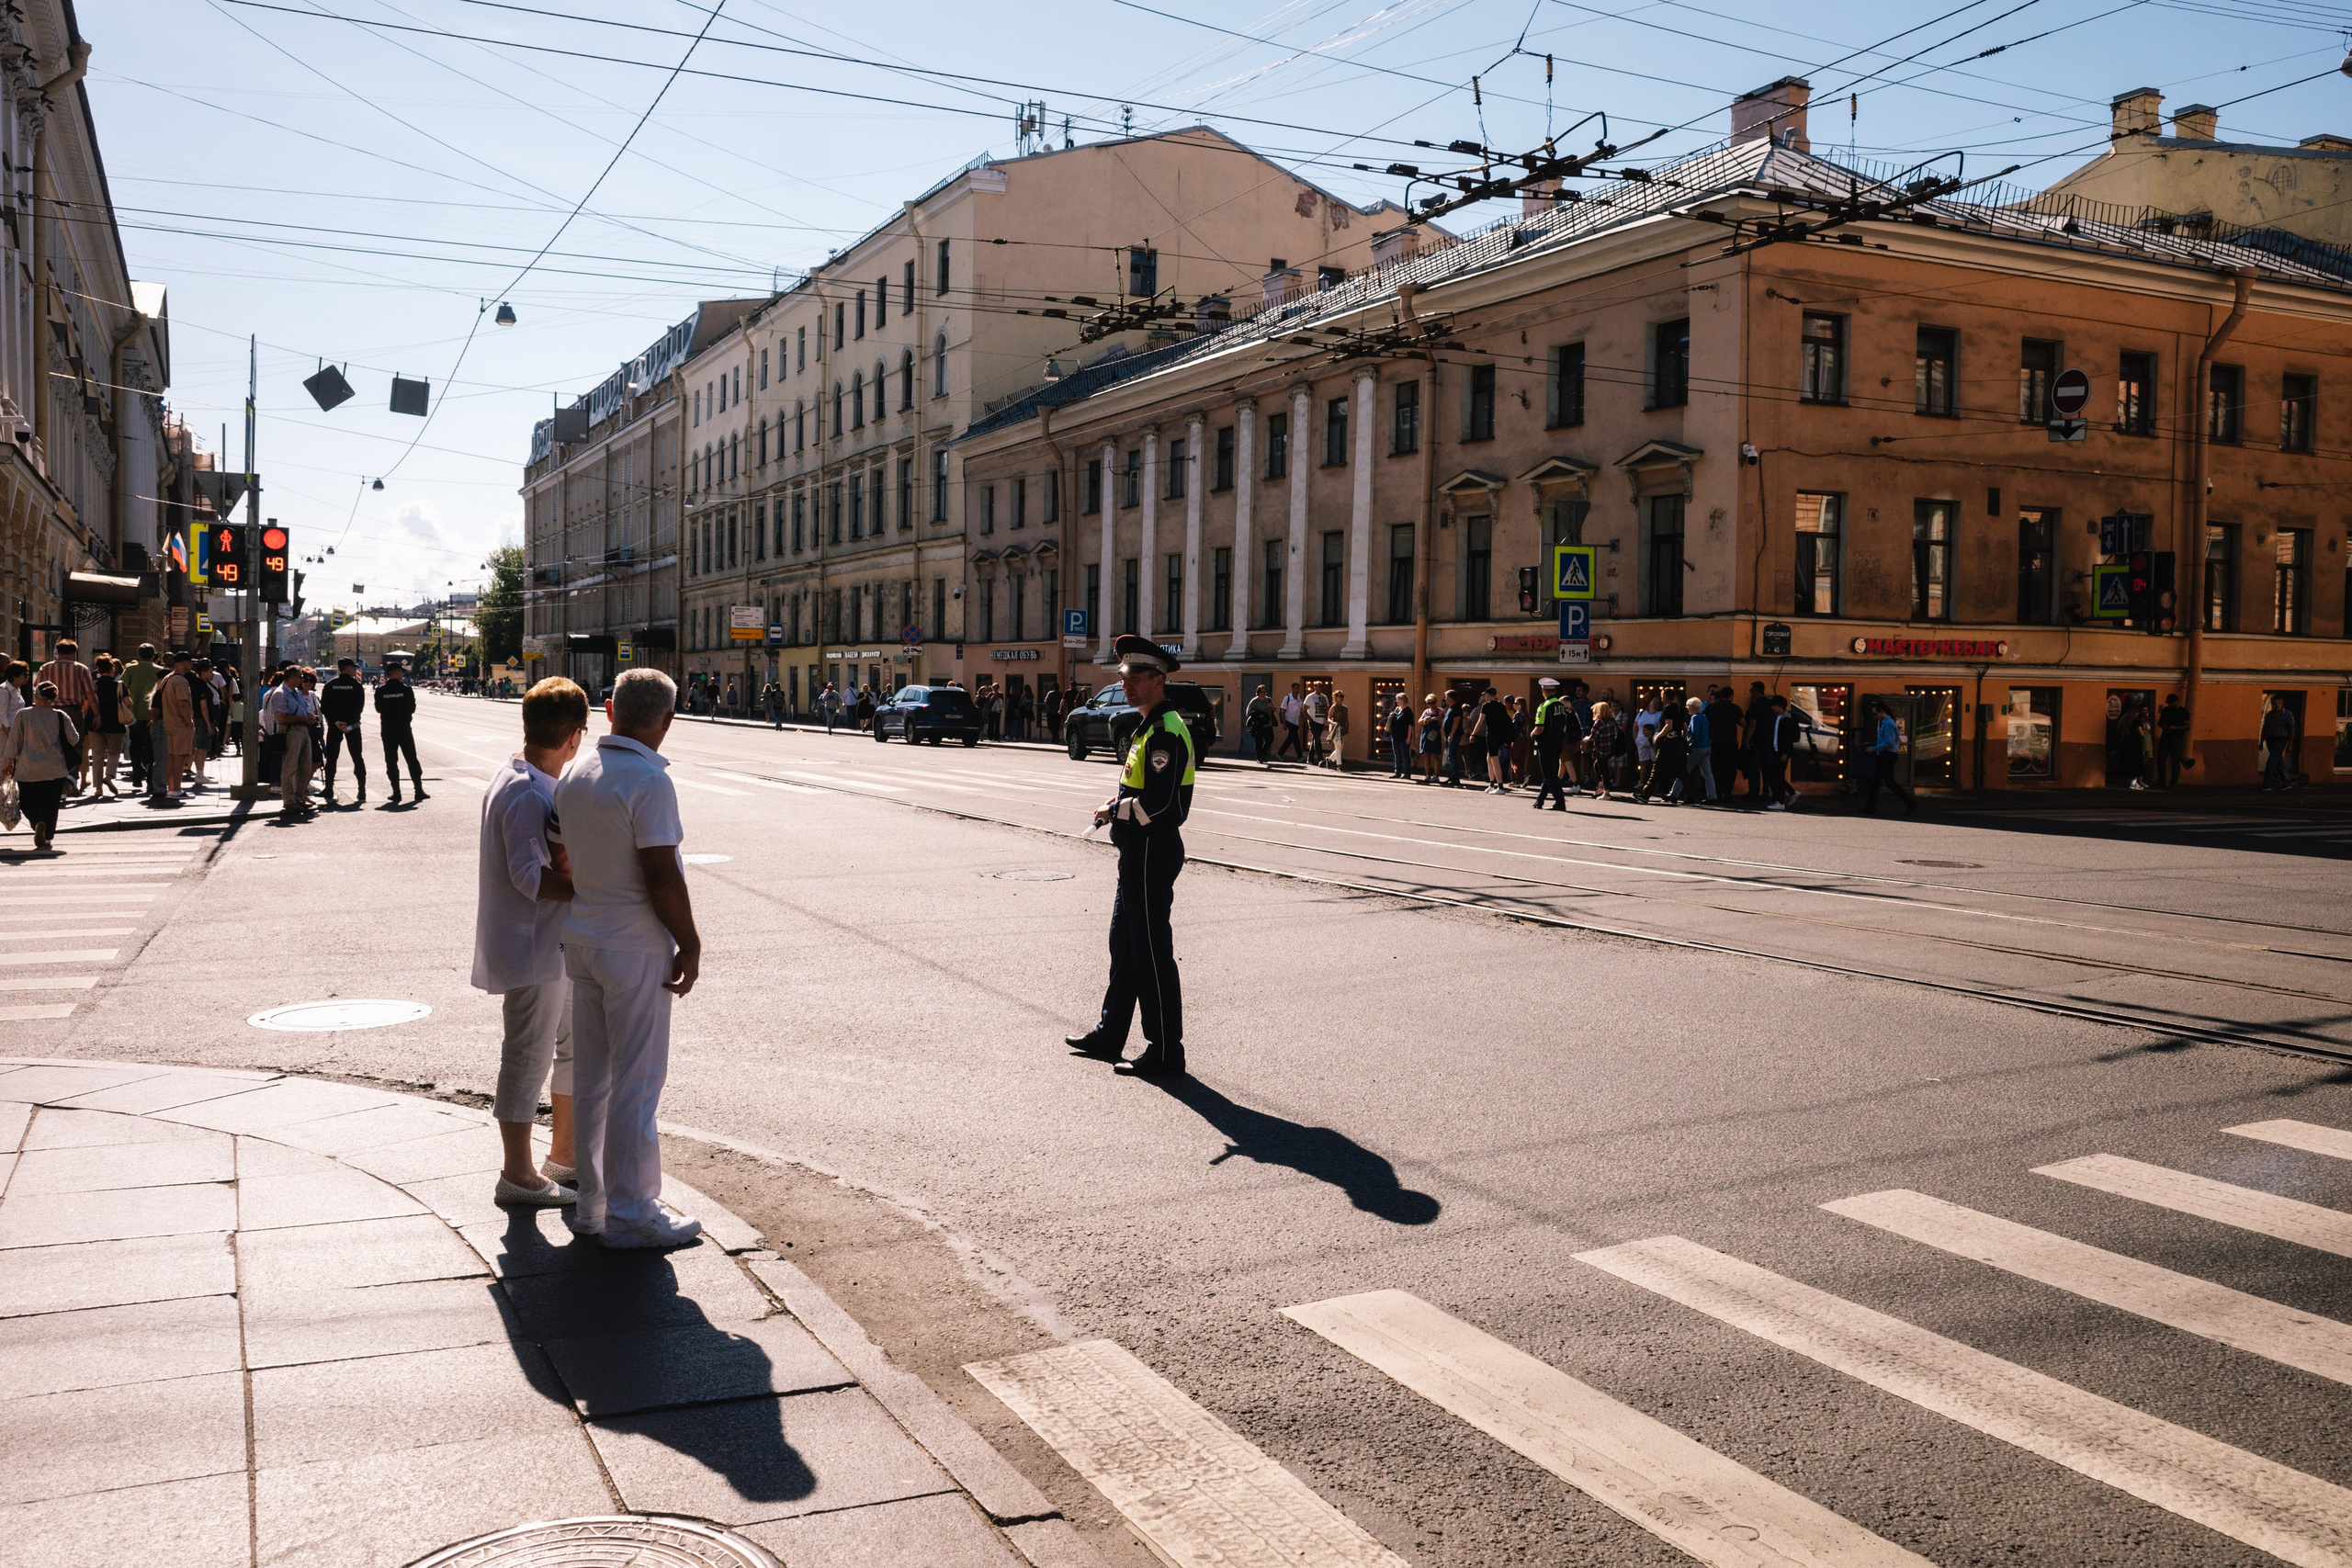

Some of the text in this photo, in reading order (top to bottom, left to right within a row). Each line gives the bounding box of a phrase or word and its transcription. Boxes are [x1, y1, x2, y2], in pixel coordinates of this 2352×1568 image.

[216, 563, 239, 581] 49
[266, 557, 284, 571] 49
[1070, 612, 1083, 632] P
[1567, 605, 1585, 636] P
[989, 650, 1037, 660] НЕМЕЦКАЯ ОБУВЬ
[1157, 644, 1182, 654] ПТИКА
